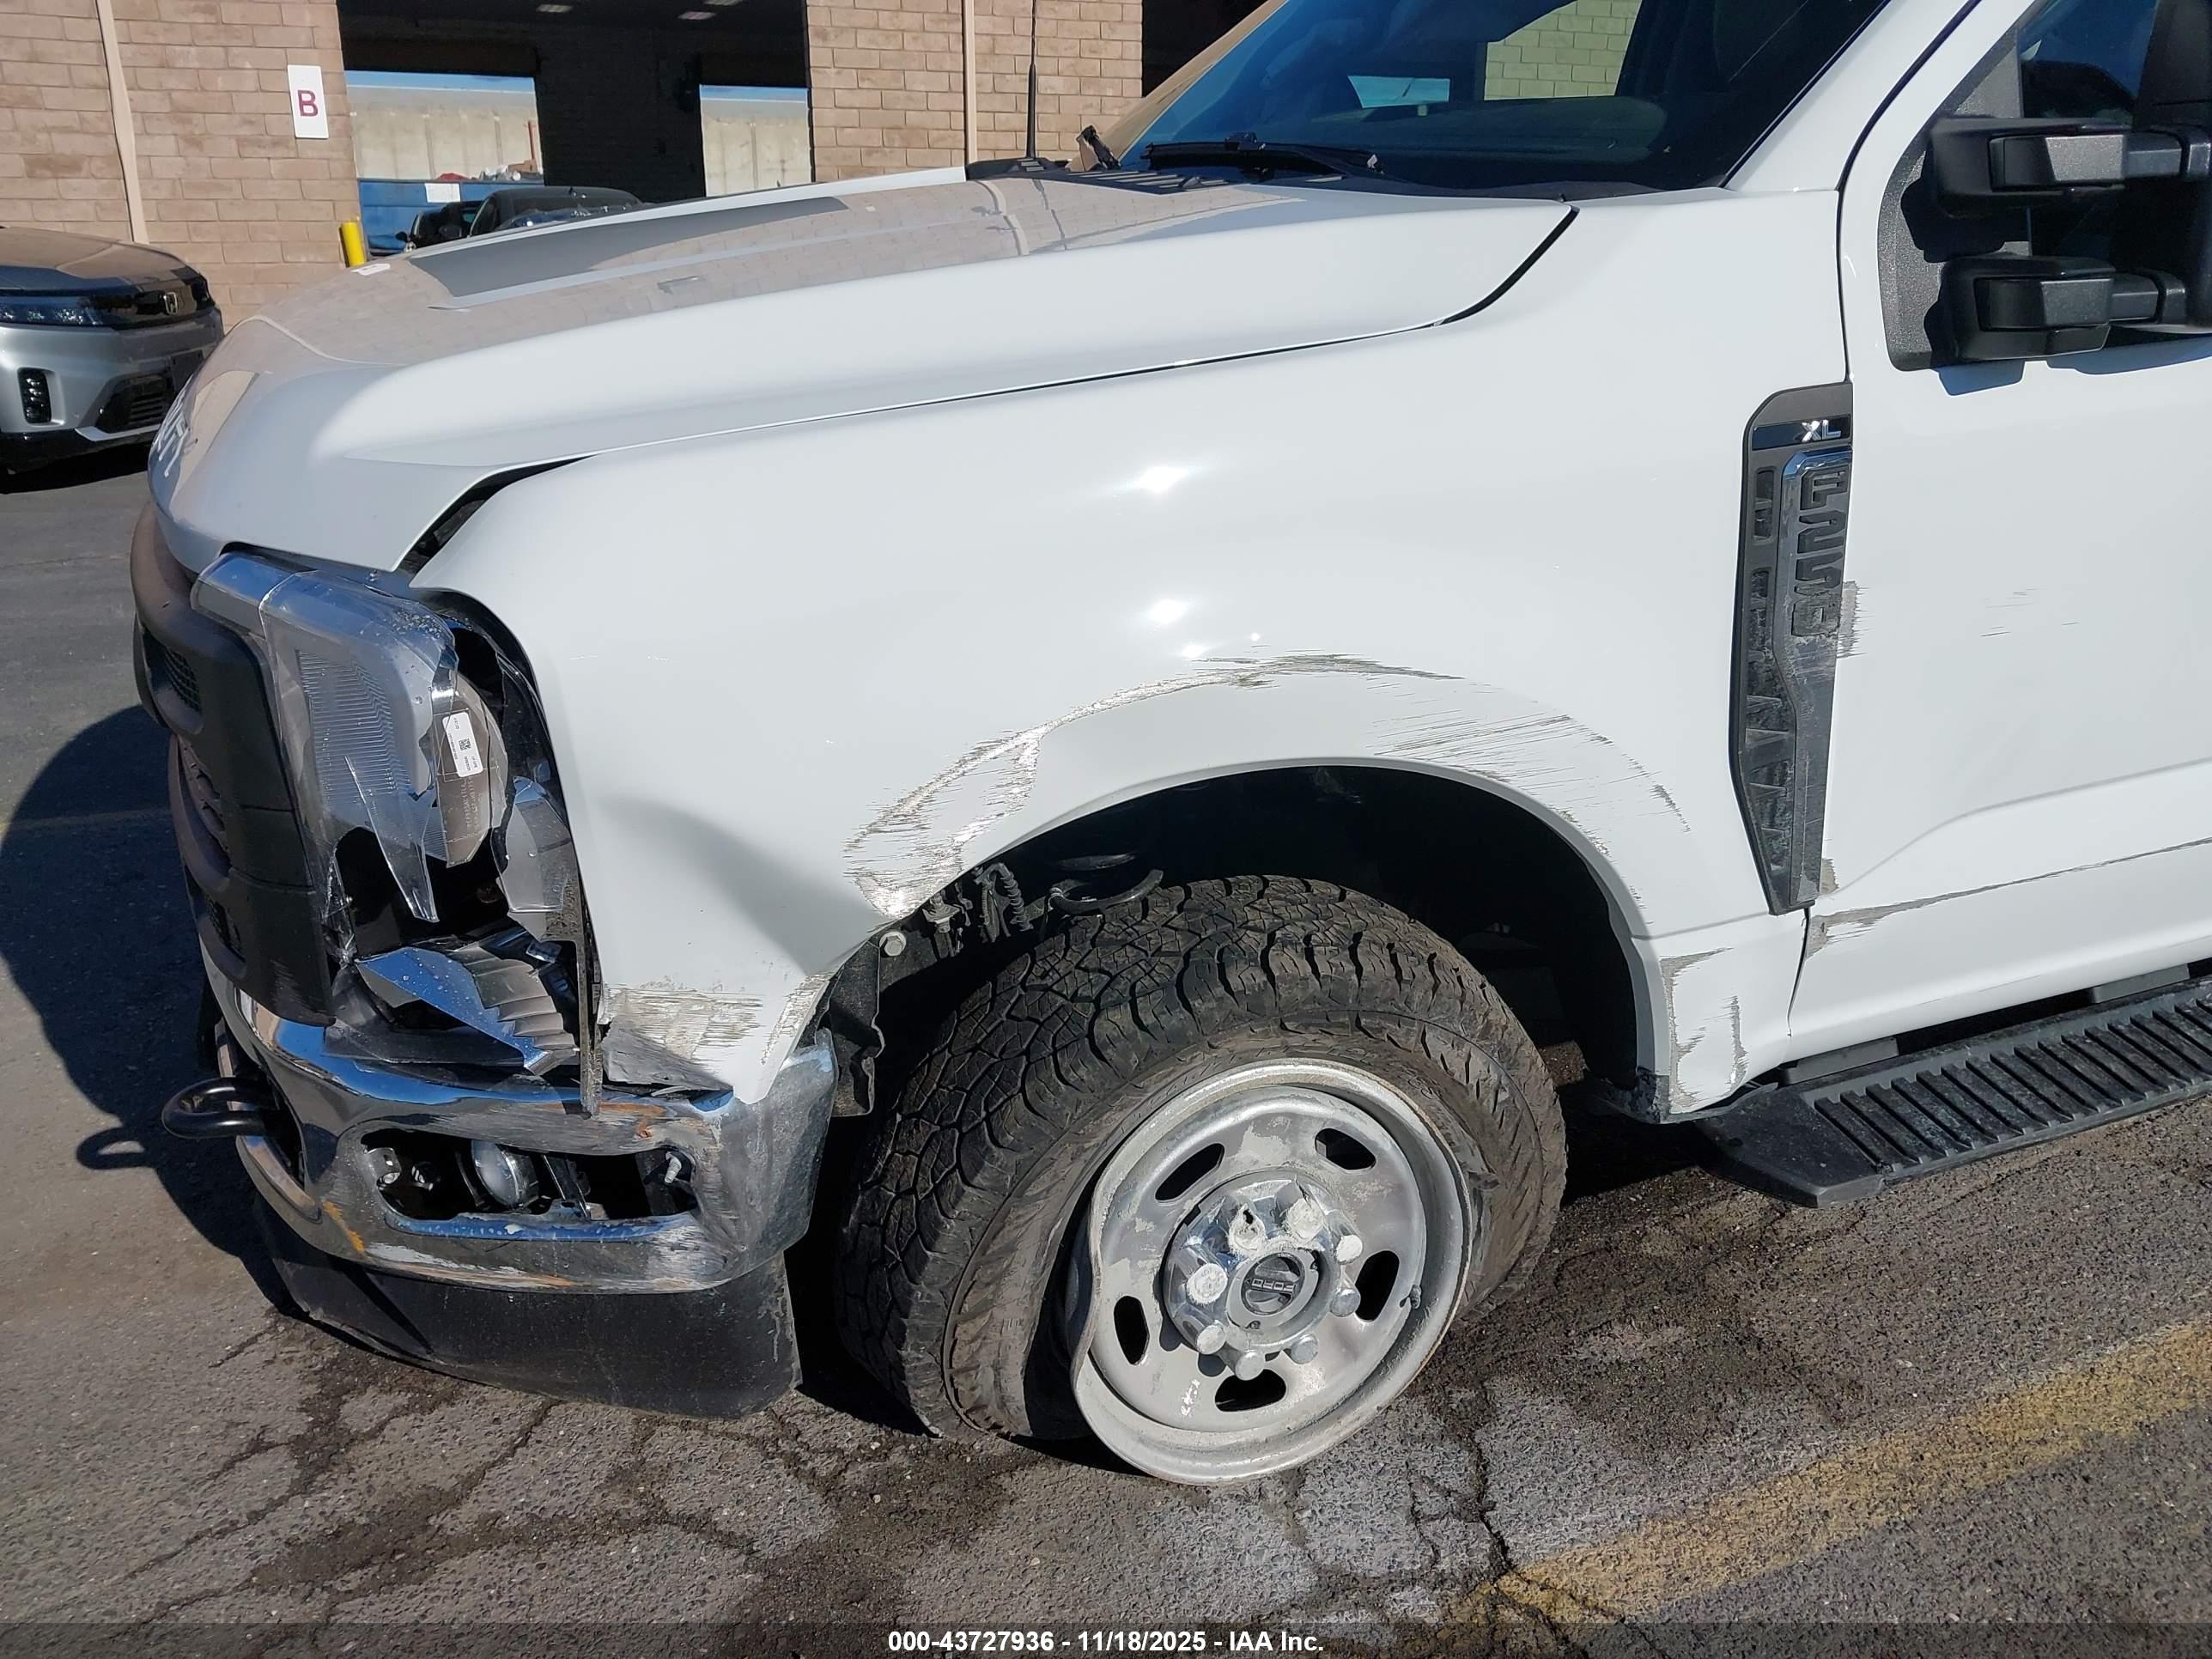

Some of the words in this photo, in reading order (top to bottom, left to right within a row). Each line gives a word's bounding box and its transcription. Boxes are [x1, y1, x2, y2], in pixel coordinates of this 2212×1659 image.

[297, 89, 319, 117] B
[1801, 419, 1842, 442] XL
[1251, 1278, 1294, 1291] FORD
